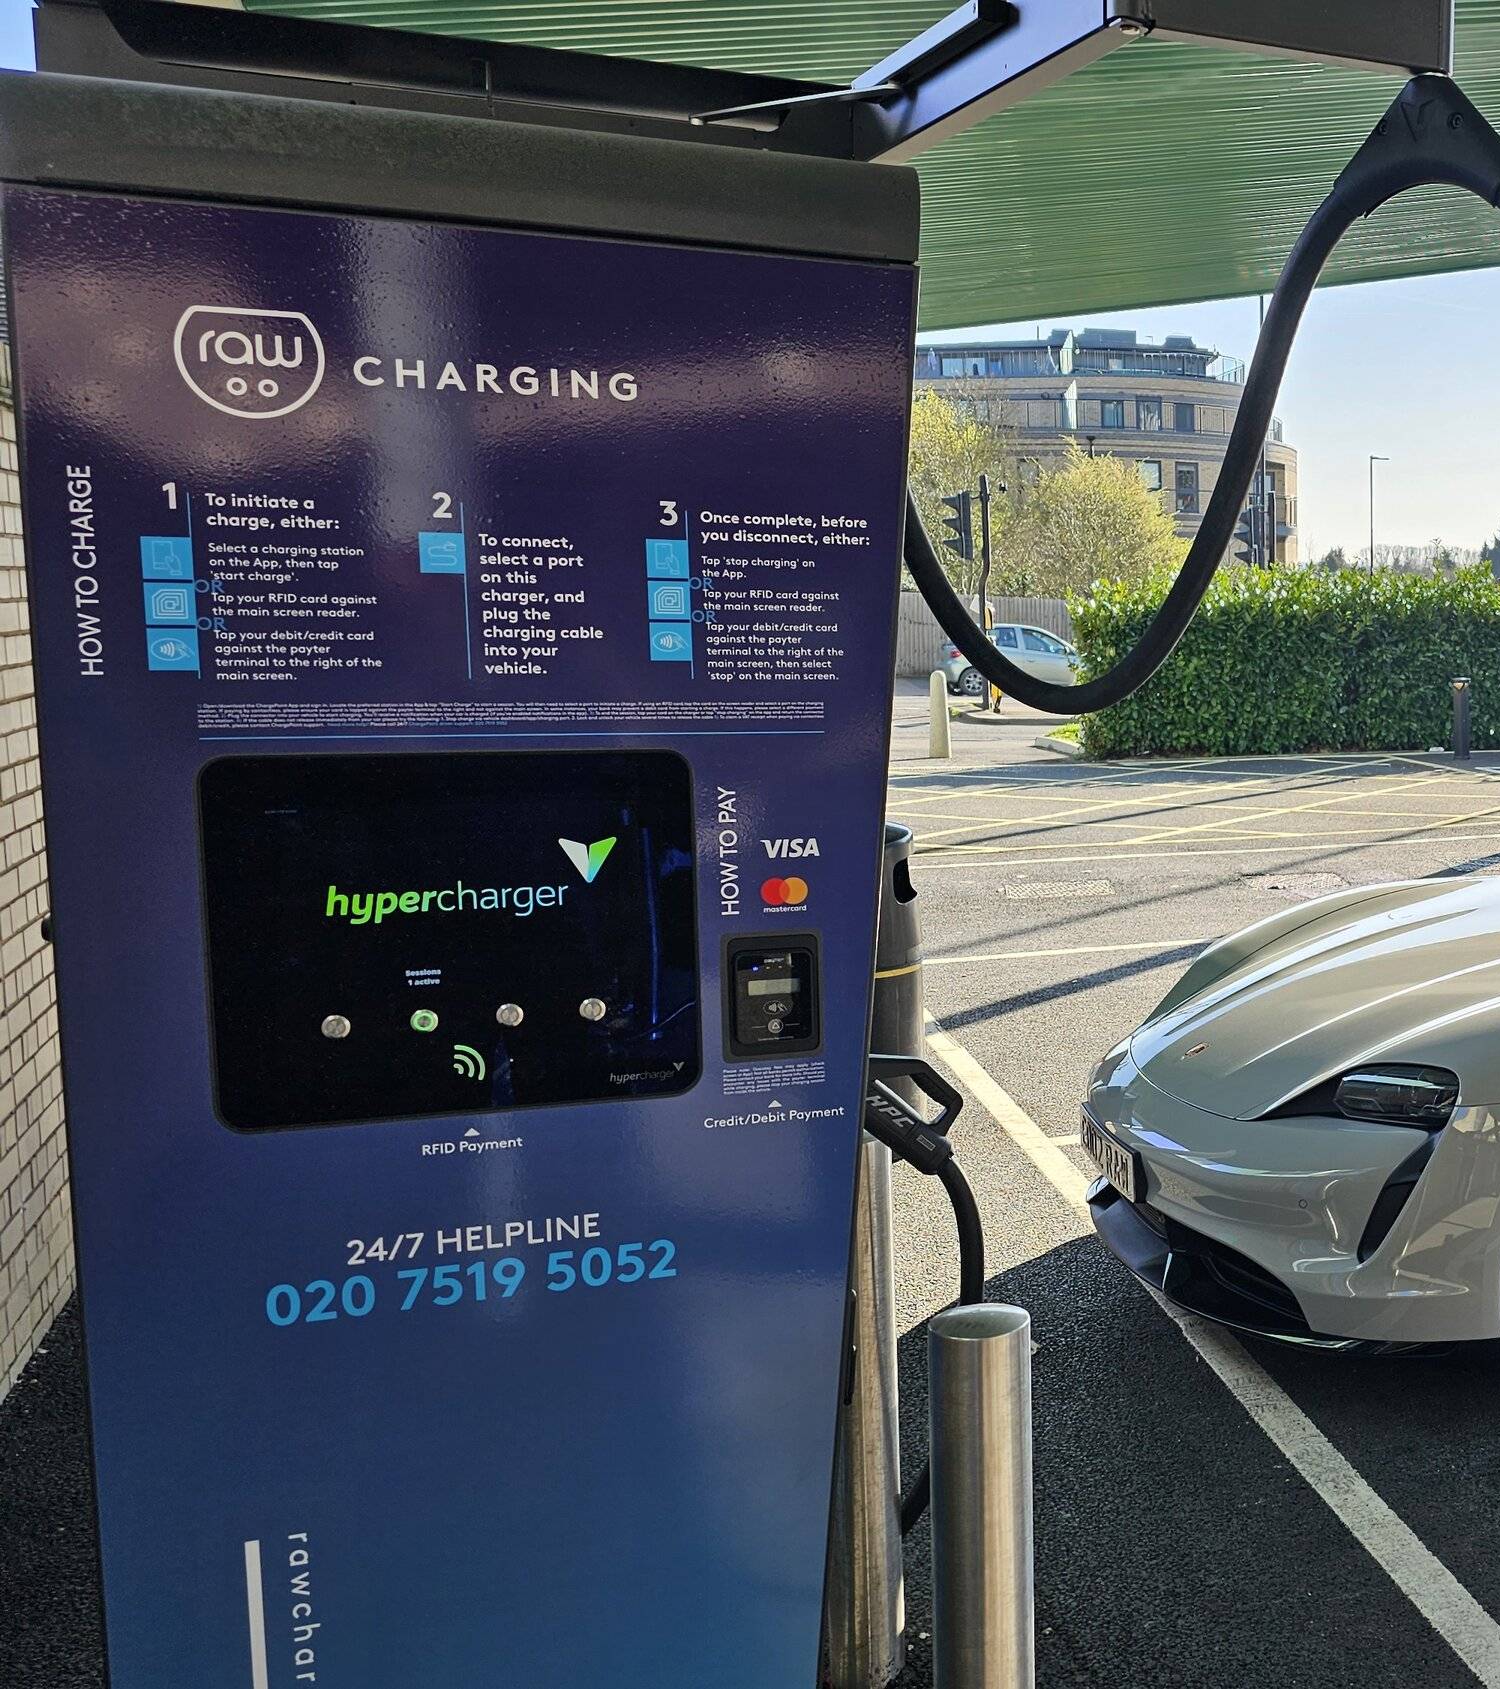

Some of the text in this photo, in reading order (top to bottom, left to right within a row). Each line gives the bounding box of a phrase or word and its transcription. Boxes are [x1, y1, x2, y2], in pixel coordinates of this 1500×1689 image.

[199, 330, 302, 369] raw
[353, 356, 638, 402] CHARGING
[162, 482, 177, 510] 1
[205, 493, 315, 510] To initiate a
[432, 492, 452, 519] 2
[659, 501, 678, 526] 3
[700, 511, 867, 528] Once complete, before
[206, 514, 340, 530] charge, either:
[479, 534, 574, 550] To connect,
[701, 530, 870, 546] you disconnect, either:
[208, 543, 246, 553] Select
[262, 545, 317, 557] charging
[321, 546, 364, 556] station
[209, 558, 339, 571] on the App, then tap
[480, 553, 584, 569] select a port
[702, 556, 720, 566] Tap
[723, 557, 748, 567] 'stop
[751, 558, 799, 569] charging'
[66, 465, 104, 675] HOW TO CHARGE
[211, 571, 299, 583] 'start charge'.
[702, 569, 746, 580] the App.
[481, 571, 537, 584] on this
[690, 578, 714, 590] OR
[194, 580, 224, 593] OR
[211, 593, 377, 607] Tap your RFID card against
[482, 589, 585, 605] charger, and
[703, 589, 721, 600] Tap
[725, 591, 747, 600] your
[750, 590, 773, 598] RFID
[802, 592, 839, 601] against
[212, 607, 359, 618] the main screen reader.
[703, 602, 720, 610] the
[724, 602, 750, 610] main
[790, 604, 825, 612] reader.
[483, 608, 551, 623] plug the
[692, 611, 716, 622] OR
[196, 618, 227, 630] OR
[706, 622, 837, 633] Tap your debit/credit card
[214, 631, 374, 642] Tap your debit/credit card
[484, 626, 603, 641] charging cable
[706, 635, 801, 645] against the payter
[215, 644, 330, 655] against the payter
[484, 644, 558, 659] into your
[706, 647, 751, 656] terminal
[767, 648, 785, 656] the
[787, 648, 811, 658] right
[814, 648, 825, 656] of
[827, 648, 844, 656] the
[215, 658, 382, 669] terminal to the right of the
[485, 662, 547, 674] vehicle.
[737, 661, 773, 669] screen,
[776, 660, 800, 668] then
[802, 660, 831, 668] select
[217, 671, 297, 681] main screen.
[708, 672, 736, 682] 'stop'
[754, 672, 771, 680] the
[774, 672, 800, 680] main
[718, 787, 740, 916] HOW TO PAY
[760, 838, 820, 858] VISA
[325, 880, 569, 925] hypercharger
[764, 904, 806, 913] mastercard
[405, 969, 441, 977] Sessions
[609, 1068, 675, 1084] hypercharger
[704, 1106, 844, 1128] Credit/Debit Payment
[865, 1095, 915, 1127] HPC
[422, 1137, 523, 1156] RFID Payment
[347, 1213, 600, 1266] 24/7 HELPLINE
[266, 1239, 677, 1326] 020 7519 5052
[288, 1532, 321, 1681] rawchar
